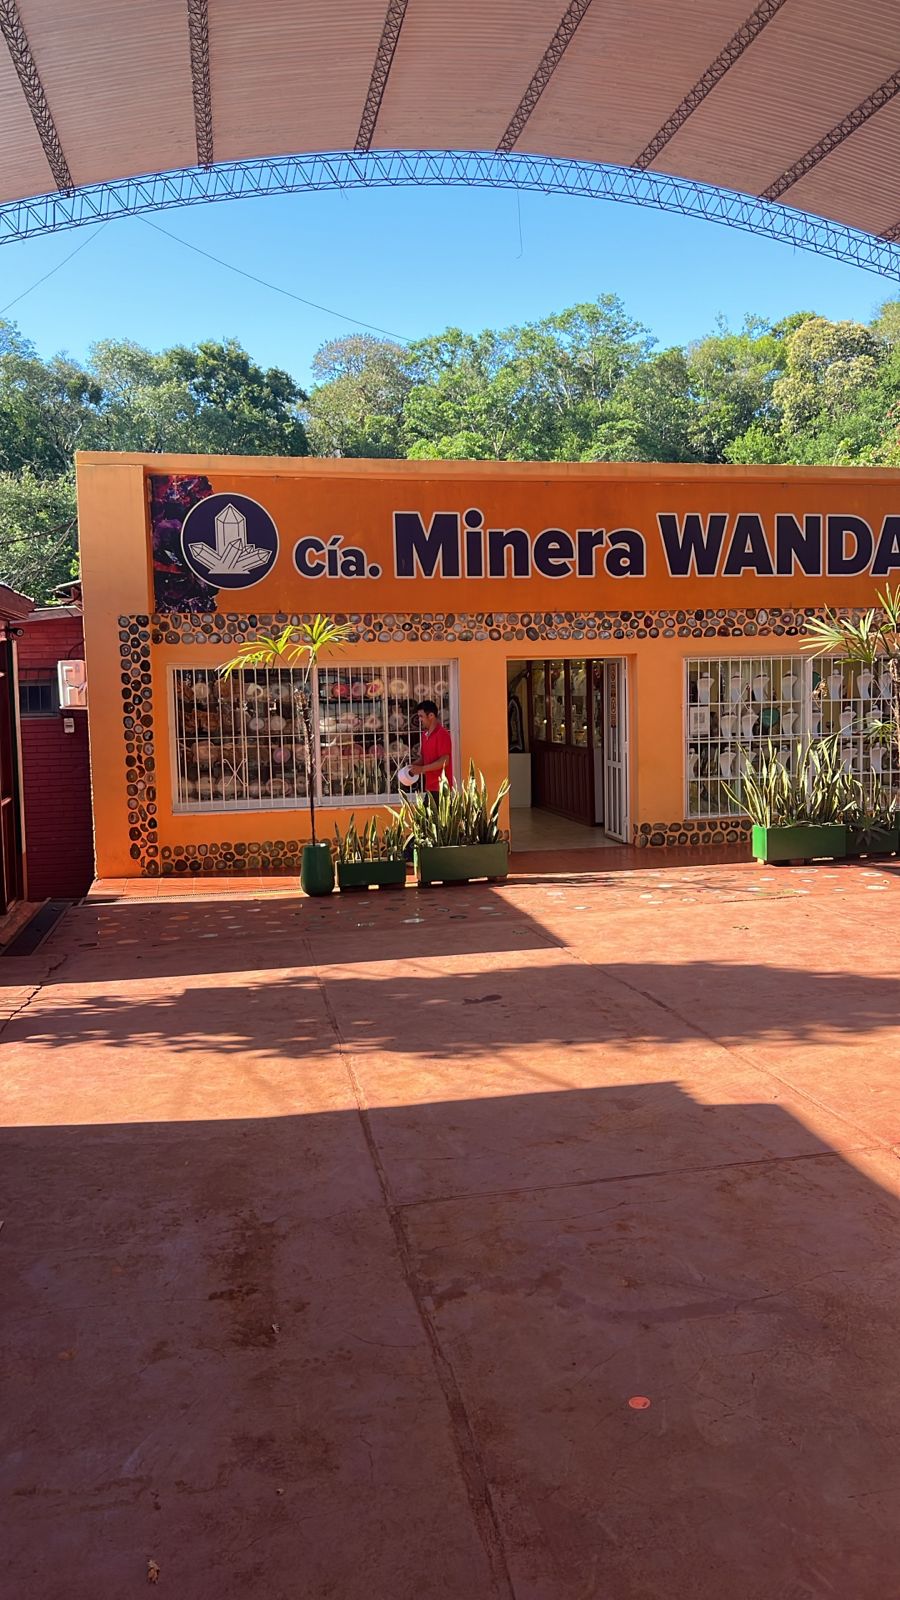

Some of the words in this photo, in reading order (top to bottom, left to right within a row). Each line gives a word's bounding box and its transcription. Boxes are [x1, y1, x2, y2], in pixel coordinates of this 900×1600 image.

[293, 535, 382, 579] Cía.
[393, 508, 646, 579] Minera
[656, 513, 900, 577] WANDA
